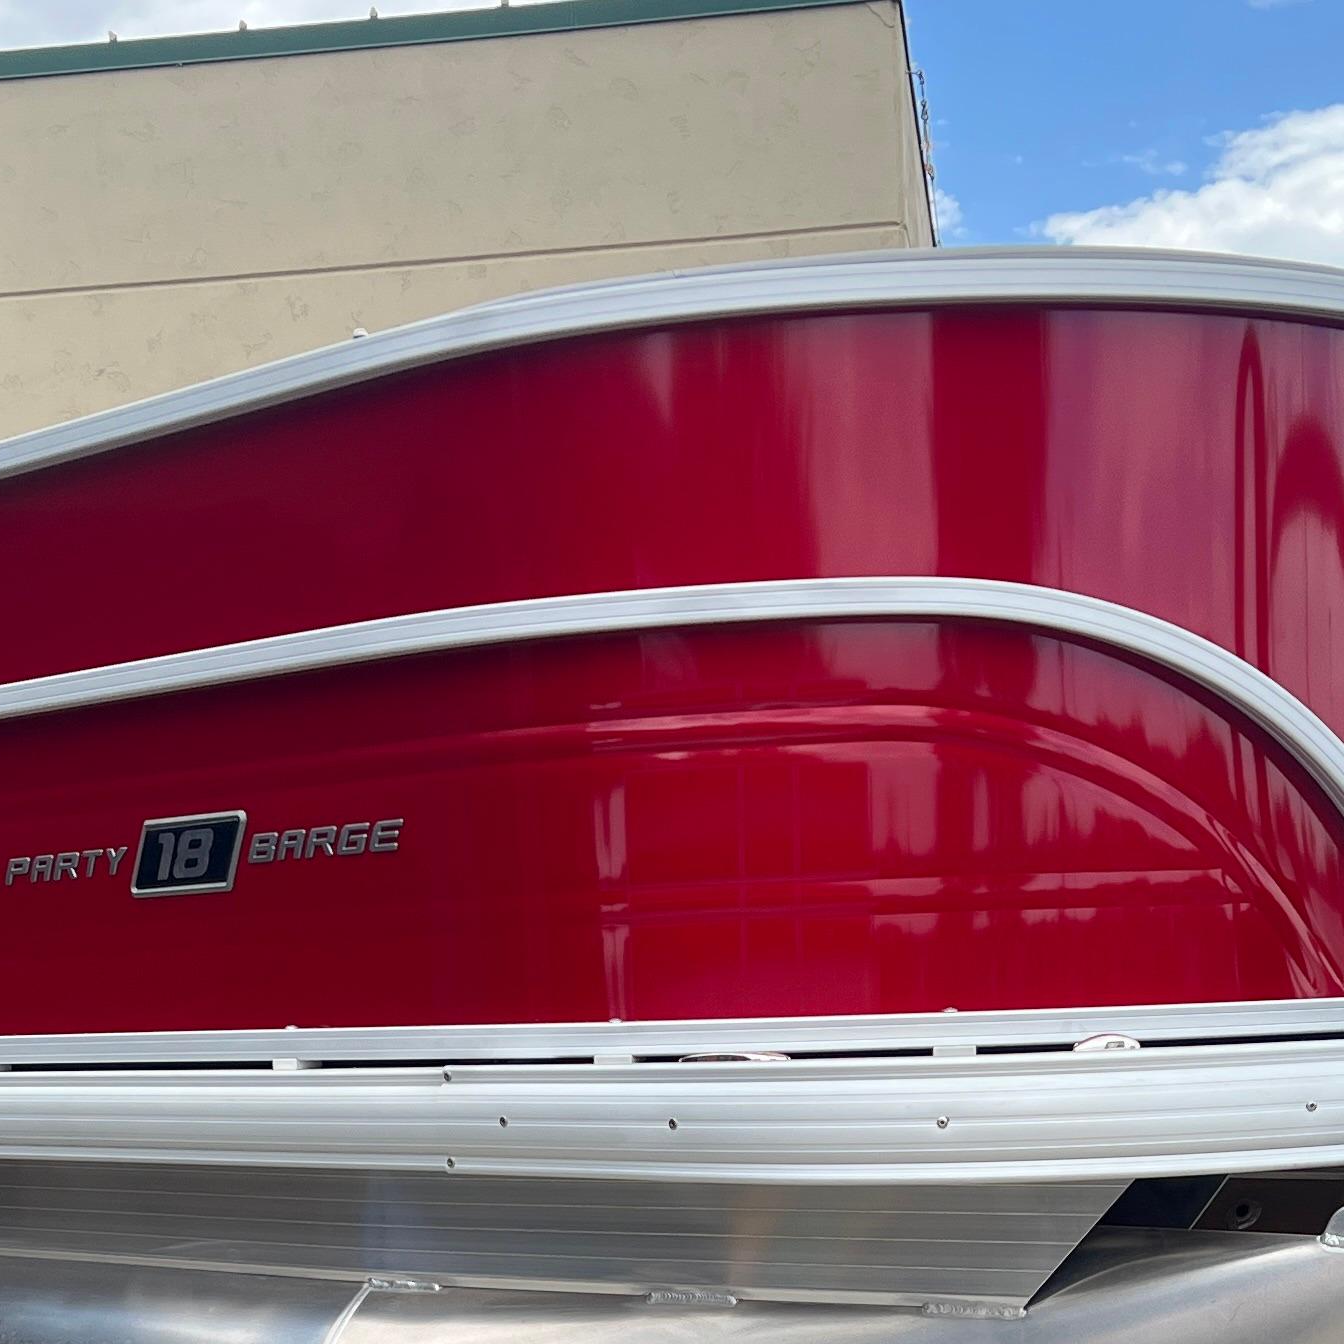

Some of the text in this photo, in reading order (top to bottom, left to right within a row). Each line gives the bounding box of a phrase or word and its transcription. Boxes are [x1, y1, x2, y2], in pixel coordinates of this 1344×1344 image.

[4, 817, 405, 886] PARTY 18 BARGE
